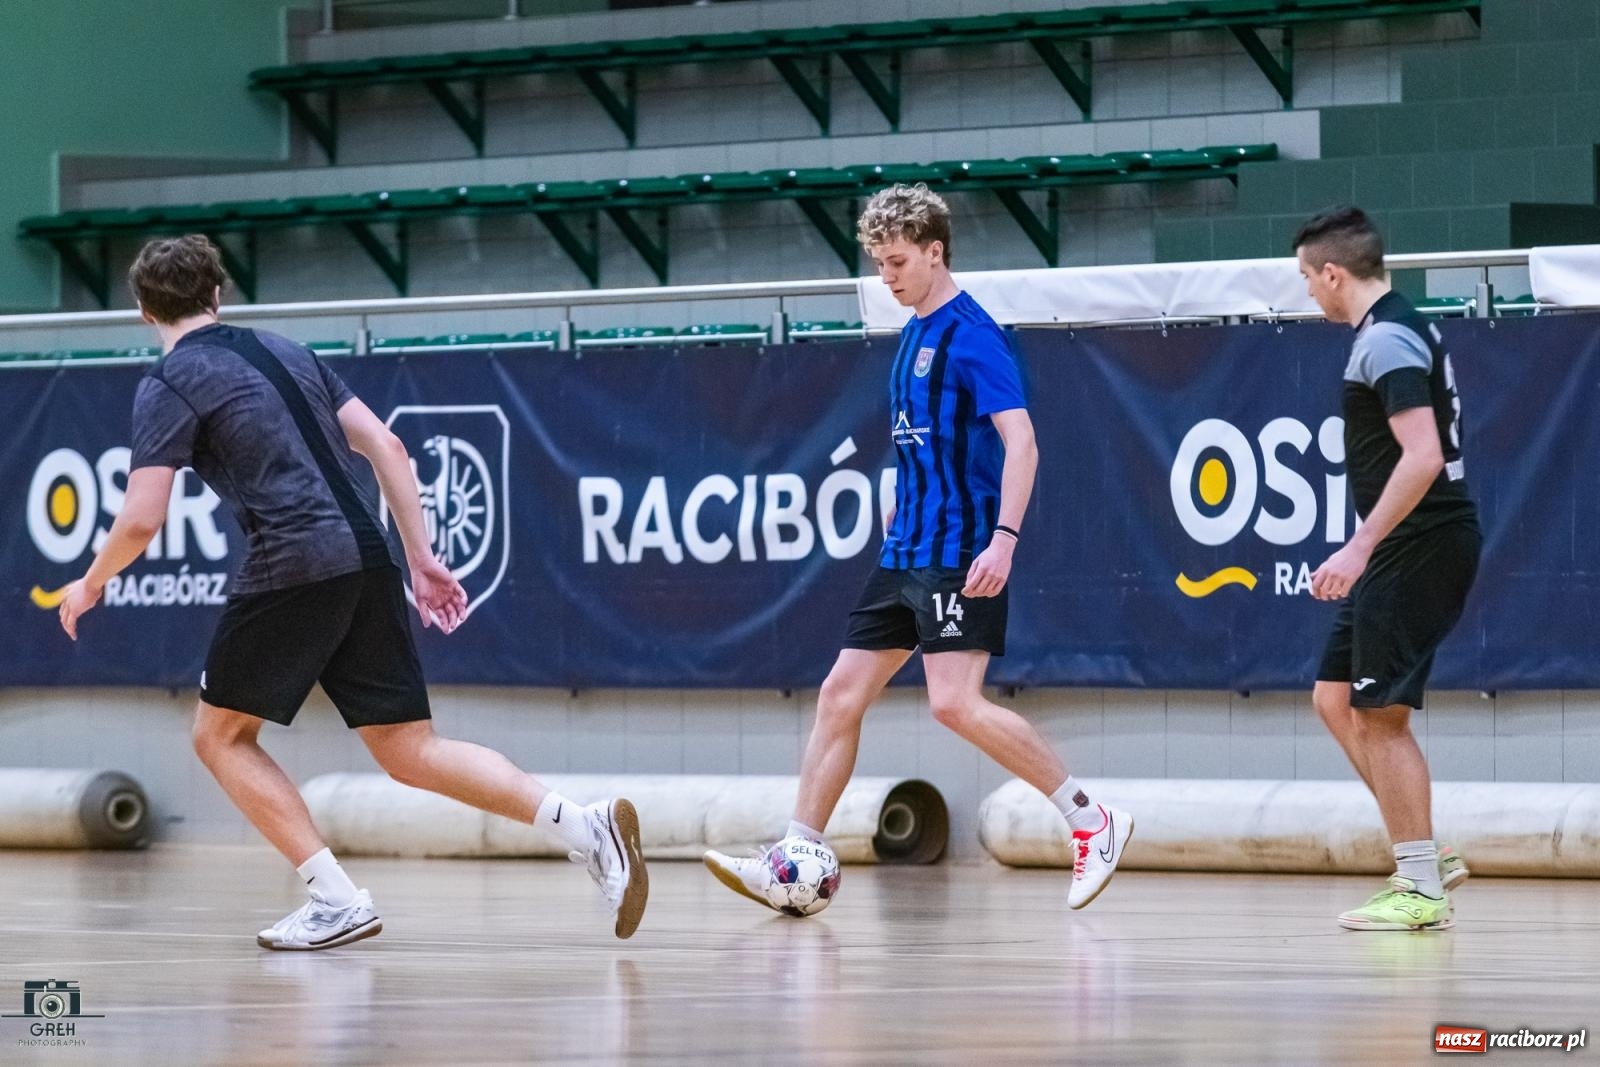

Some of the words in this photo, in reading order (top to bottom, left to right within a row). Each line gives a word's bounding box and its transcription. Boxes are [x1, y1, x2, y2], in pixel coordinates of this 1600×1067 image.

[1170, 415, 1361, 546] OSi
[26, 446, 228, 563] OSR
[103, 563, 228, 607] RACIBÓRZ
[1275, 562, 1314, 596] RA
[932, 593, 964, 621] 14
[940, 630, 962, 638] adidas
[791, 845, 832, 863] SELECT
